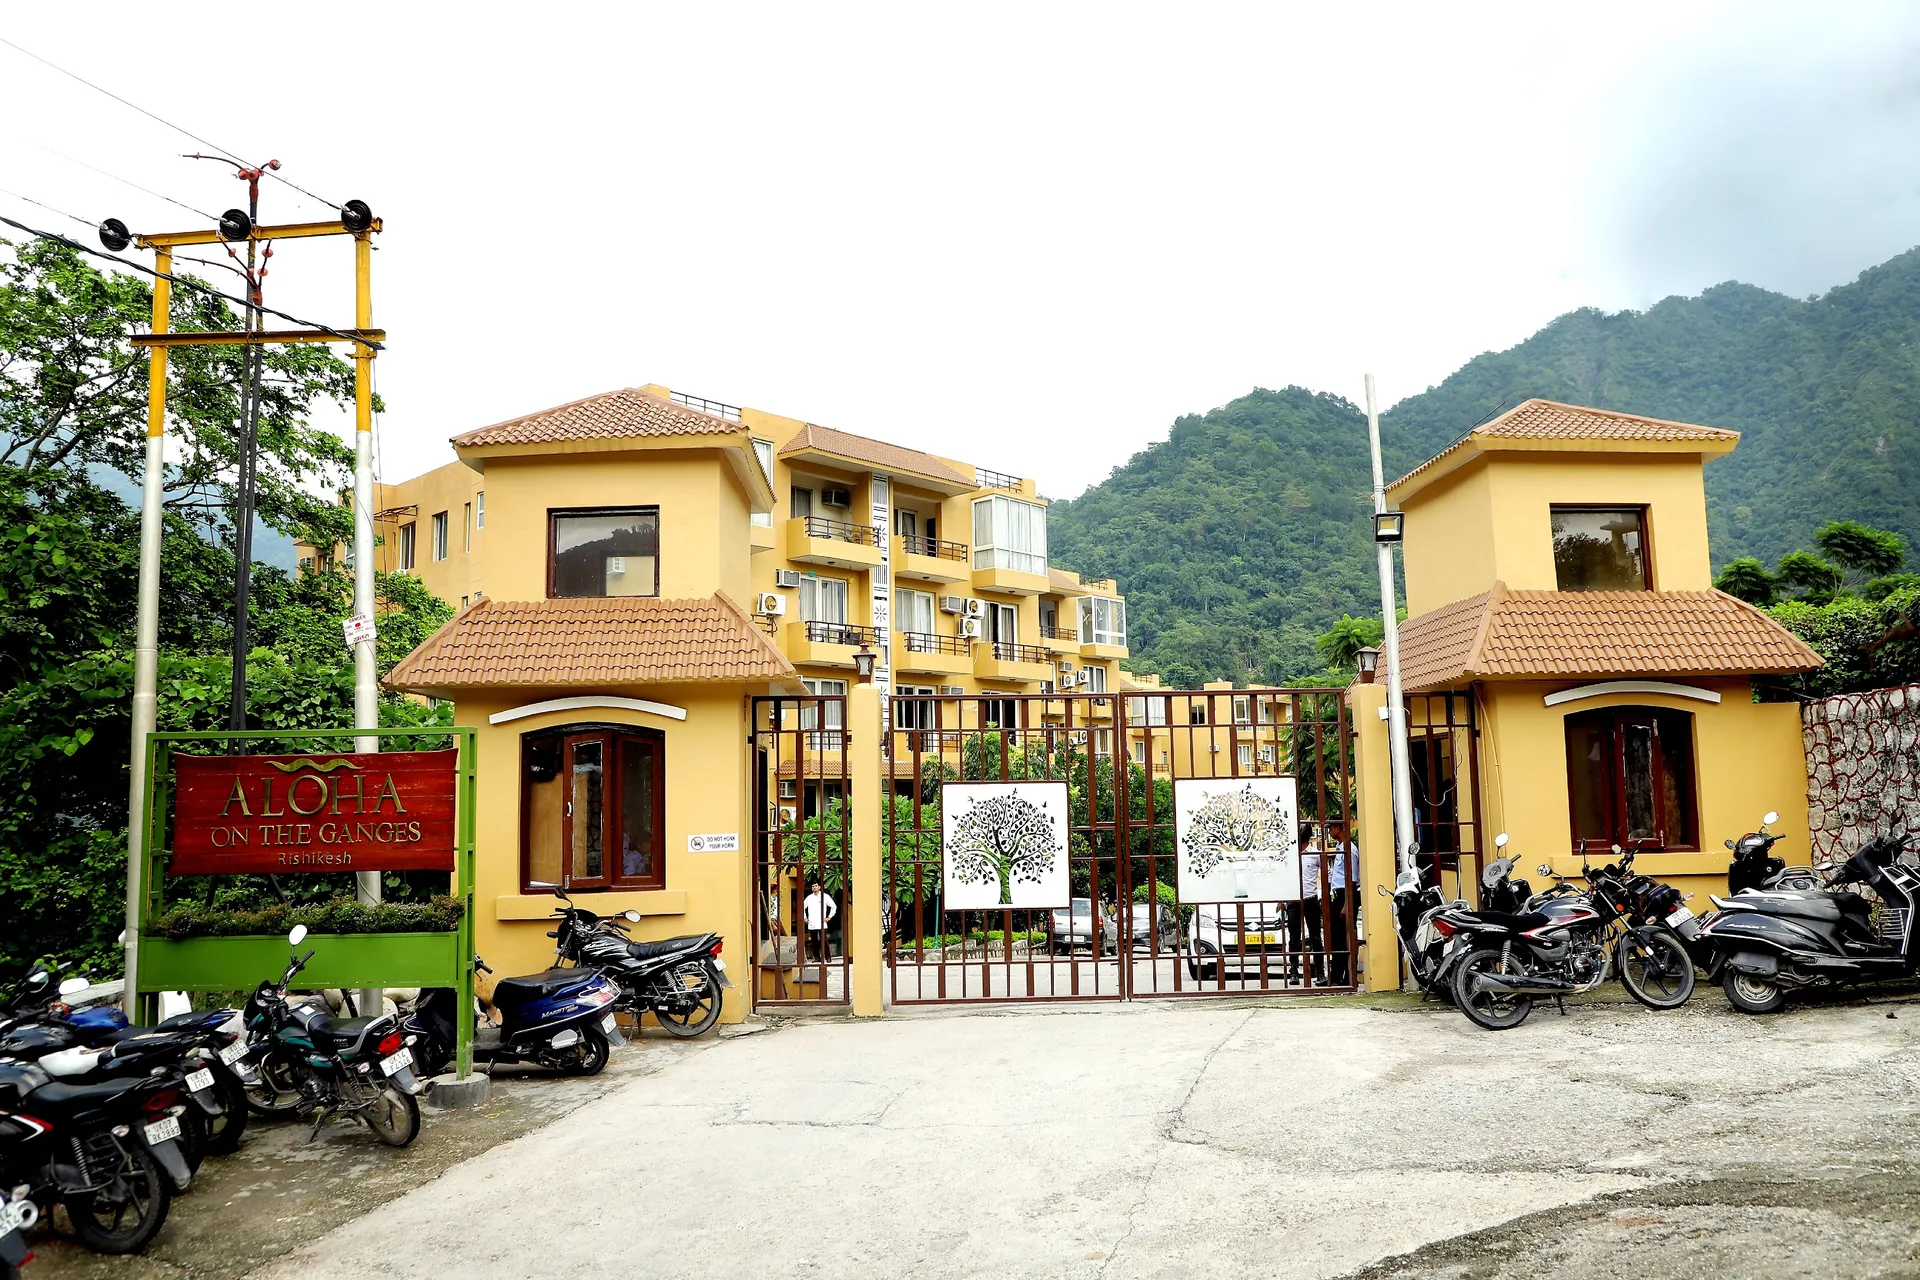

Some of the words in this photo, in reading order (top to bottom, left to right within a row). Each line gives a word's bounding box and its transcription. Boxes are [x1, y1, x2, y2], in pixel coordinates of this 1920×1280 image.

[218, 773, 408, 817] ALOHA
[211, 826, 249, 847] ON
[259, 824, 312, 845] THE
[318, 821, 421, 844] GANGES
[277, 851, 352, 866] Rishikesh
